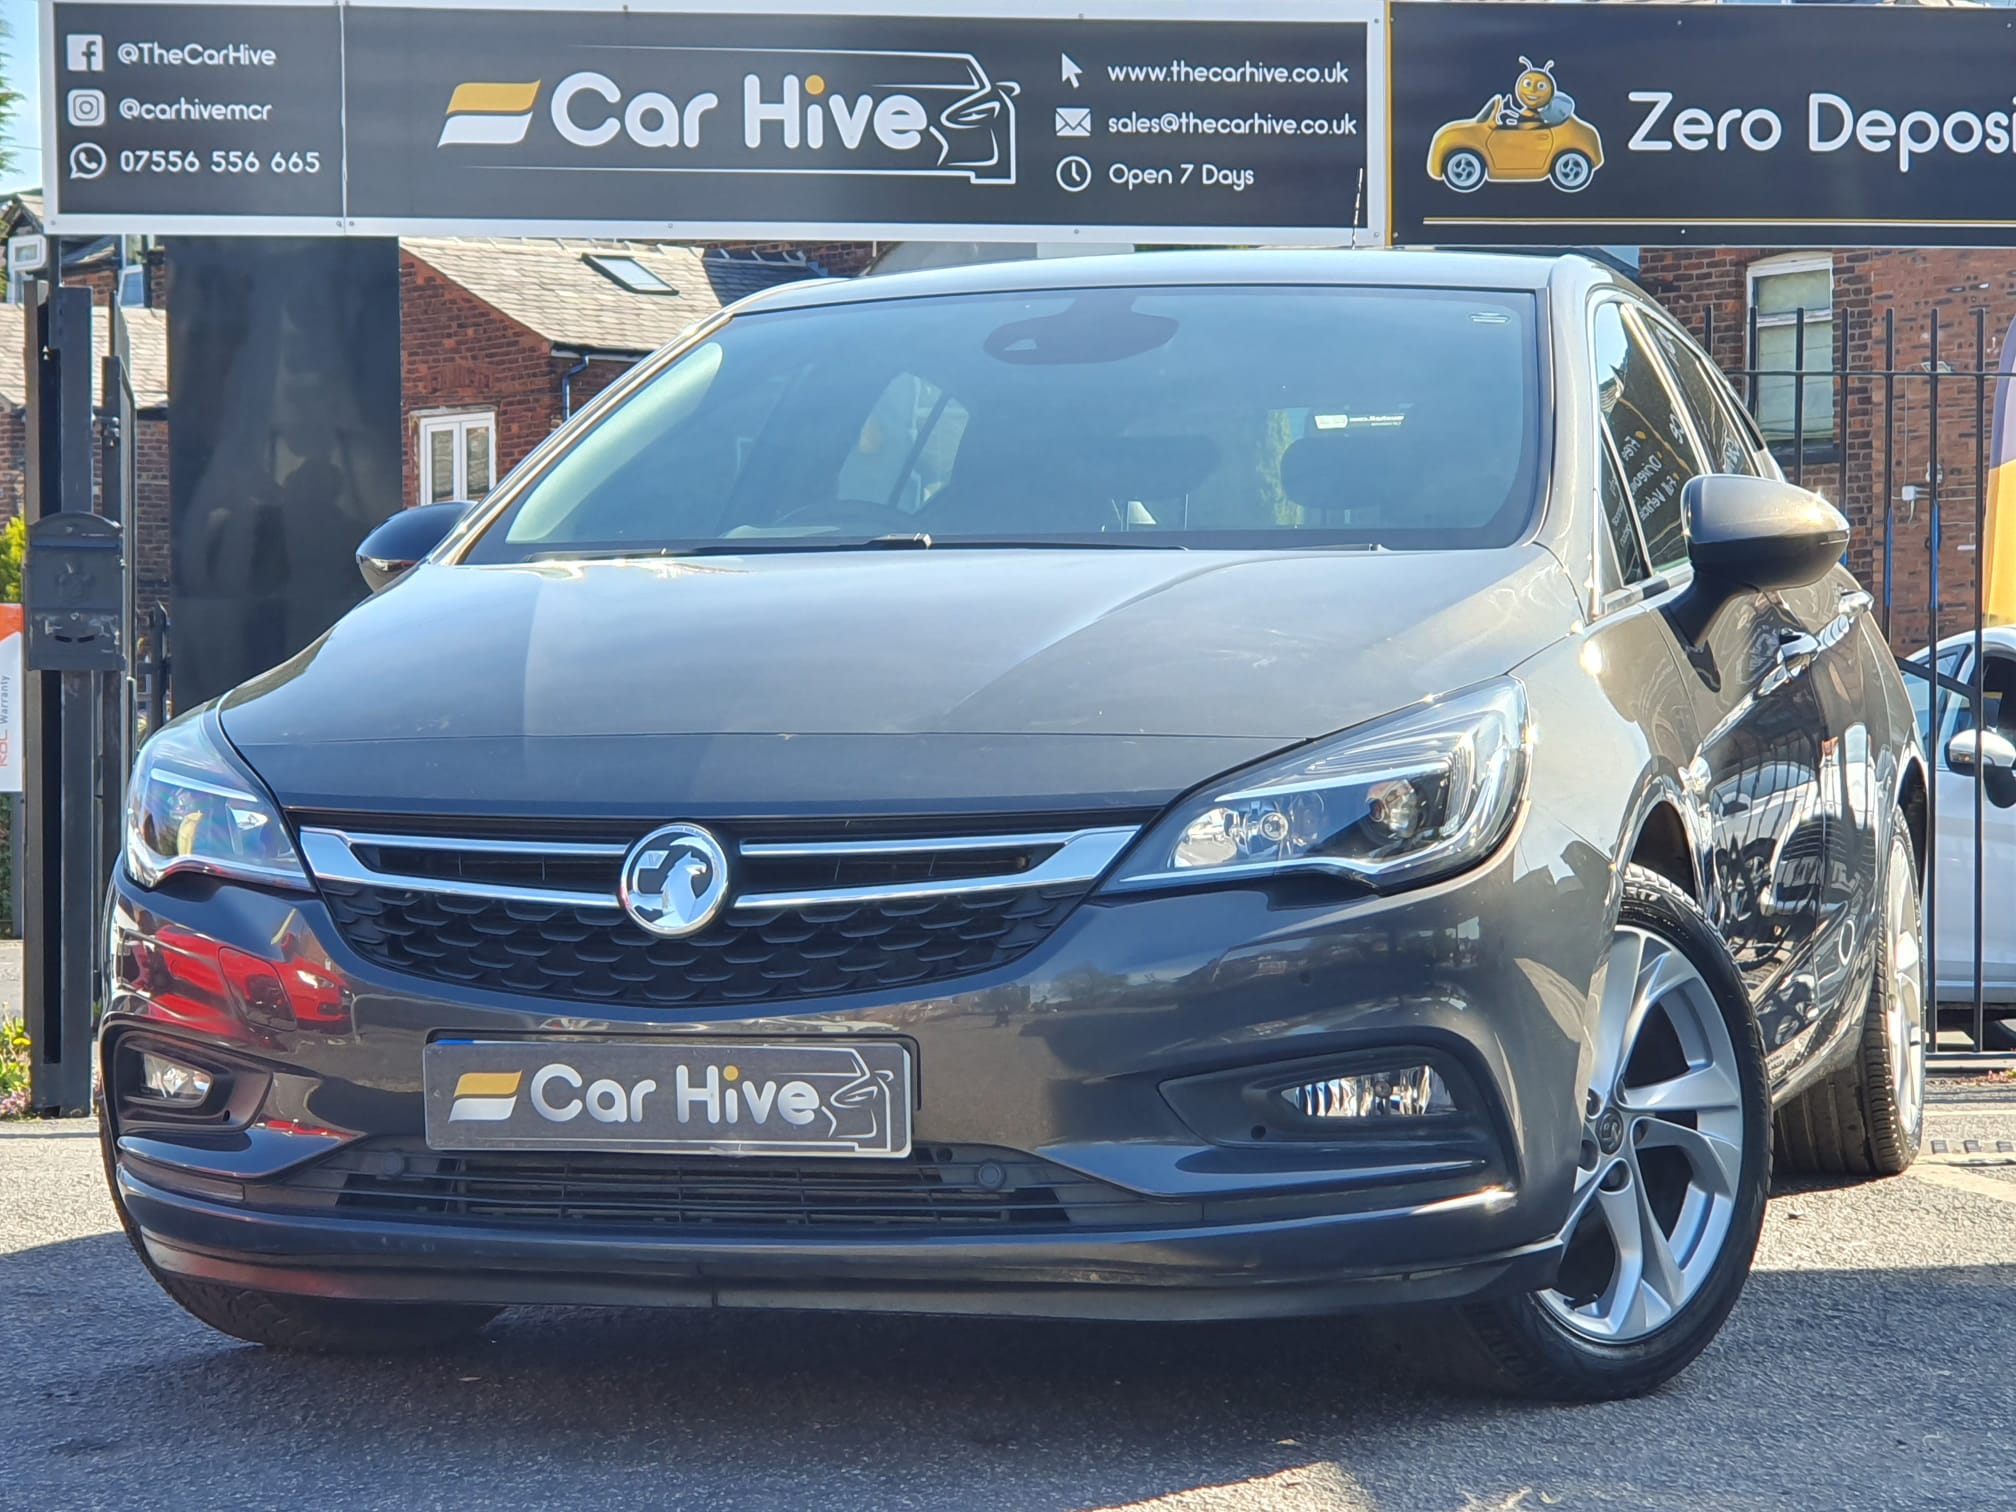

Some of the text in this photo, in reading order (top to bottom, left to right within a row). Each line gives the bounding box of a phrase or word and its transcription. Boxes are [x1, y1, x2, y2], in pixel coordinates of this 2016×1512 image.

[117, 42, 277, 67] @TheCarHive
[1107, 59, 1350, 84] www.thecarhive.co.uk
[119, 97, 273, 122] @carhivemcr
[550, 71, 928, 150] Car Hive
[1627, 91, 1783, 151] Zero
[1107, 111, 1358, 136] sales@thecarhive.co.uk
[119, 150, 321, 174] 07556 556 665
[1108, 163, 1255, 192] Open 7 Days
[530, 1063, 821, 1125] Car Hive
